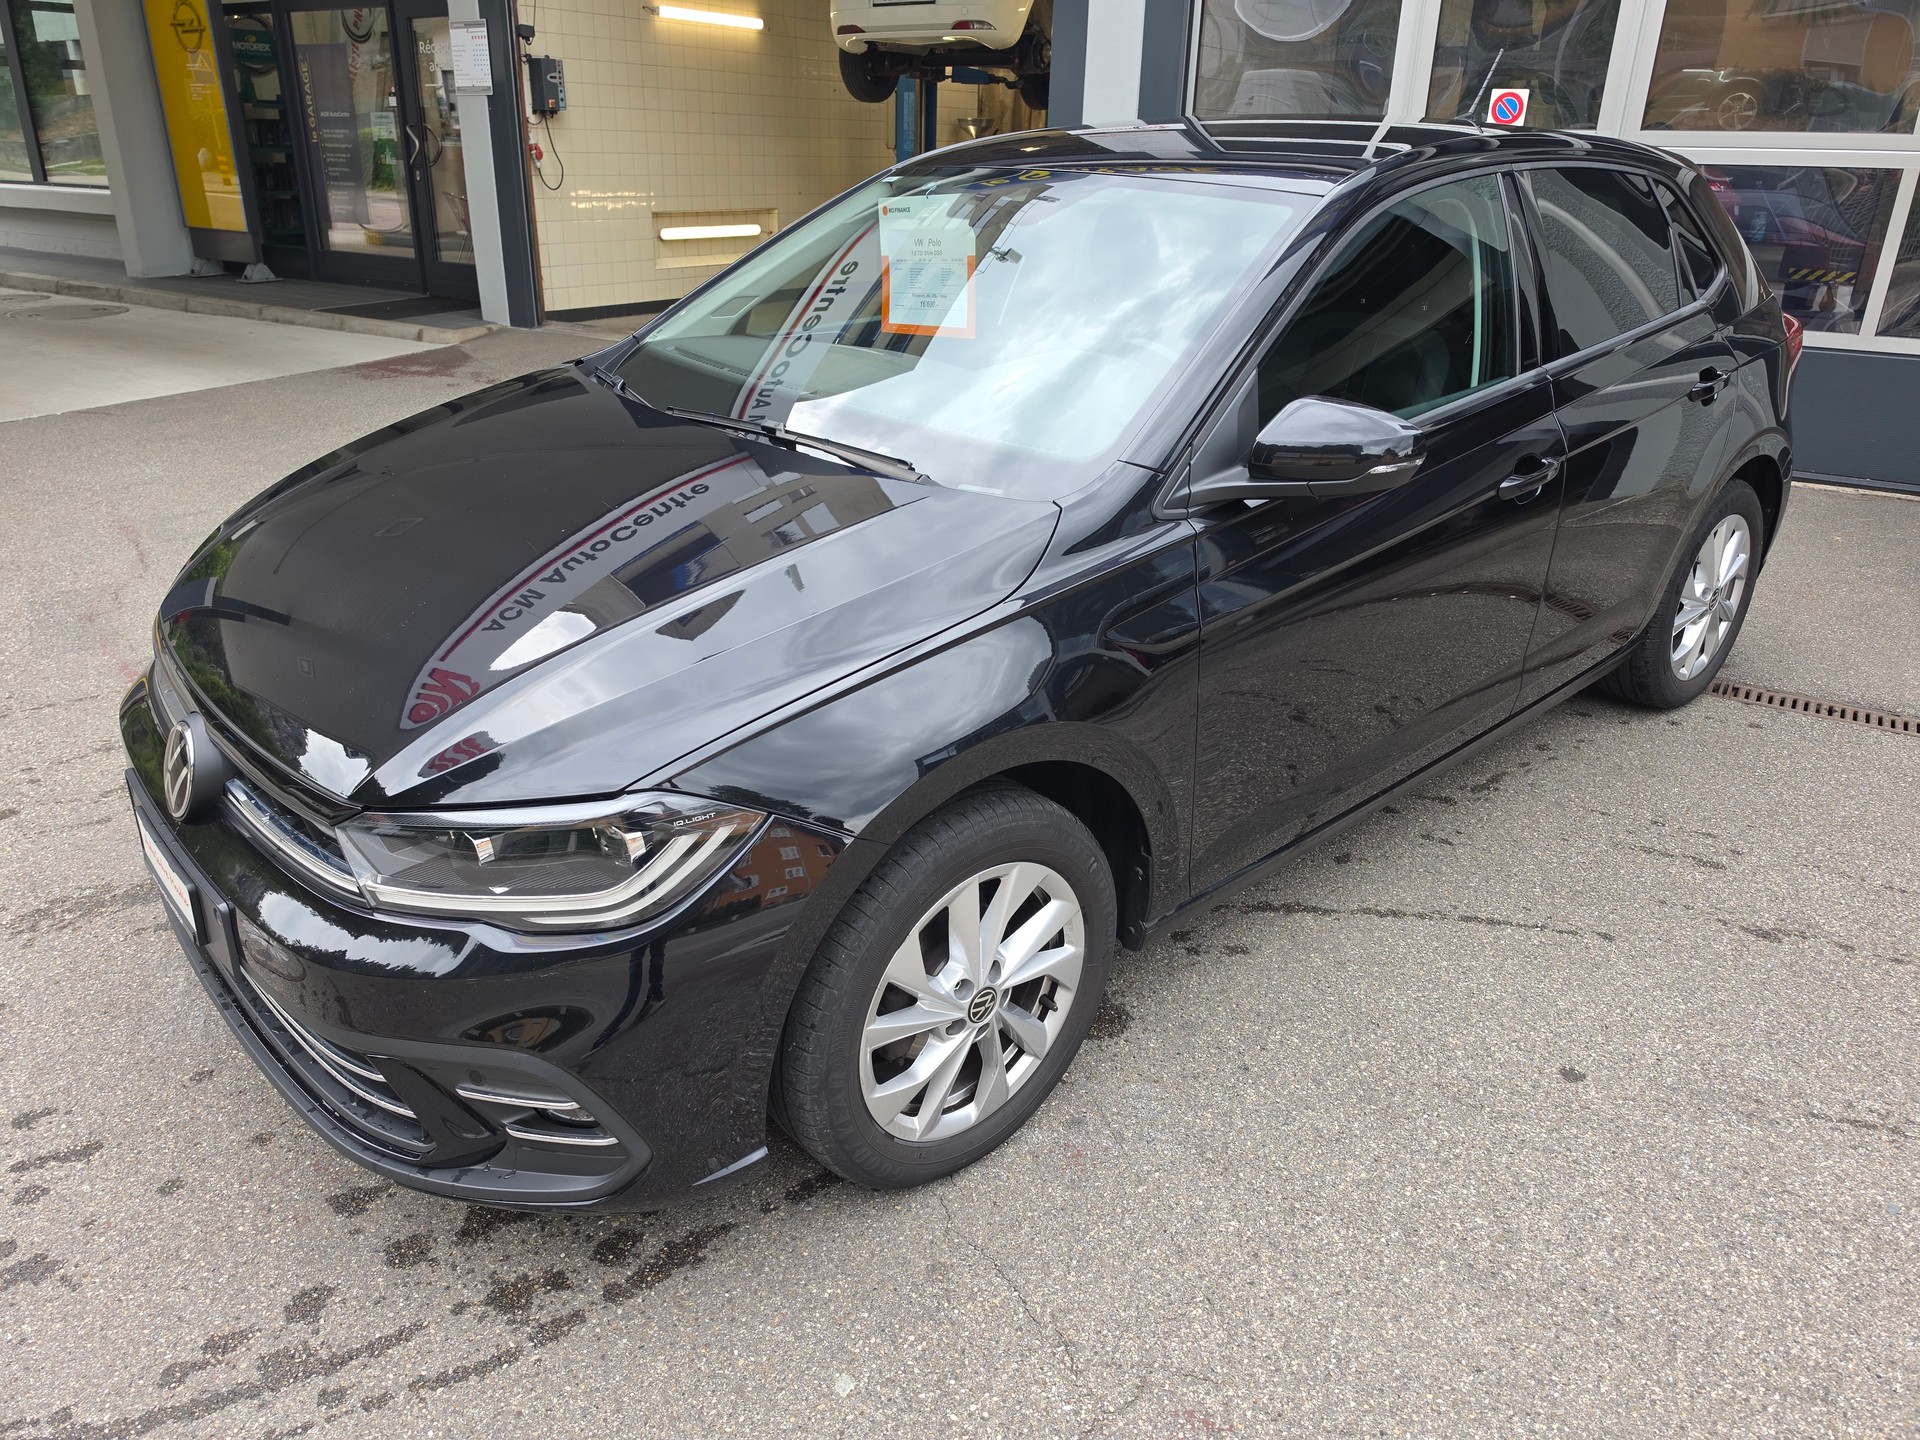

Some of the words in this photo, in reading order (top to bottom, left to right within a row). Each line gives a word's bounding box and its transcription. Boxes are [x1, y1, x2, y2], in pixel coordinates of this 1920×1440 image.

[231, 41, 271, 52] MOTOREX
[300, 62, 316, 128] GARAGE
[913, 238, 925, 247] VW
[928, 238, 942, 247] Polo
[673, 812, 716, 827] IQ.LIGHT
